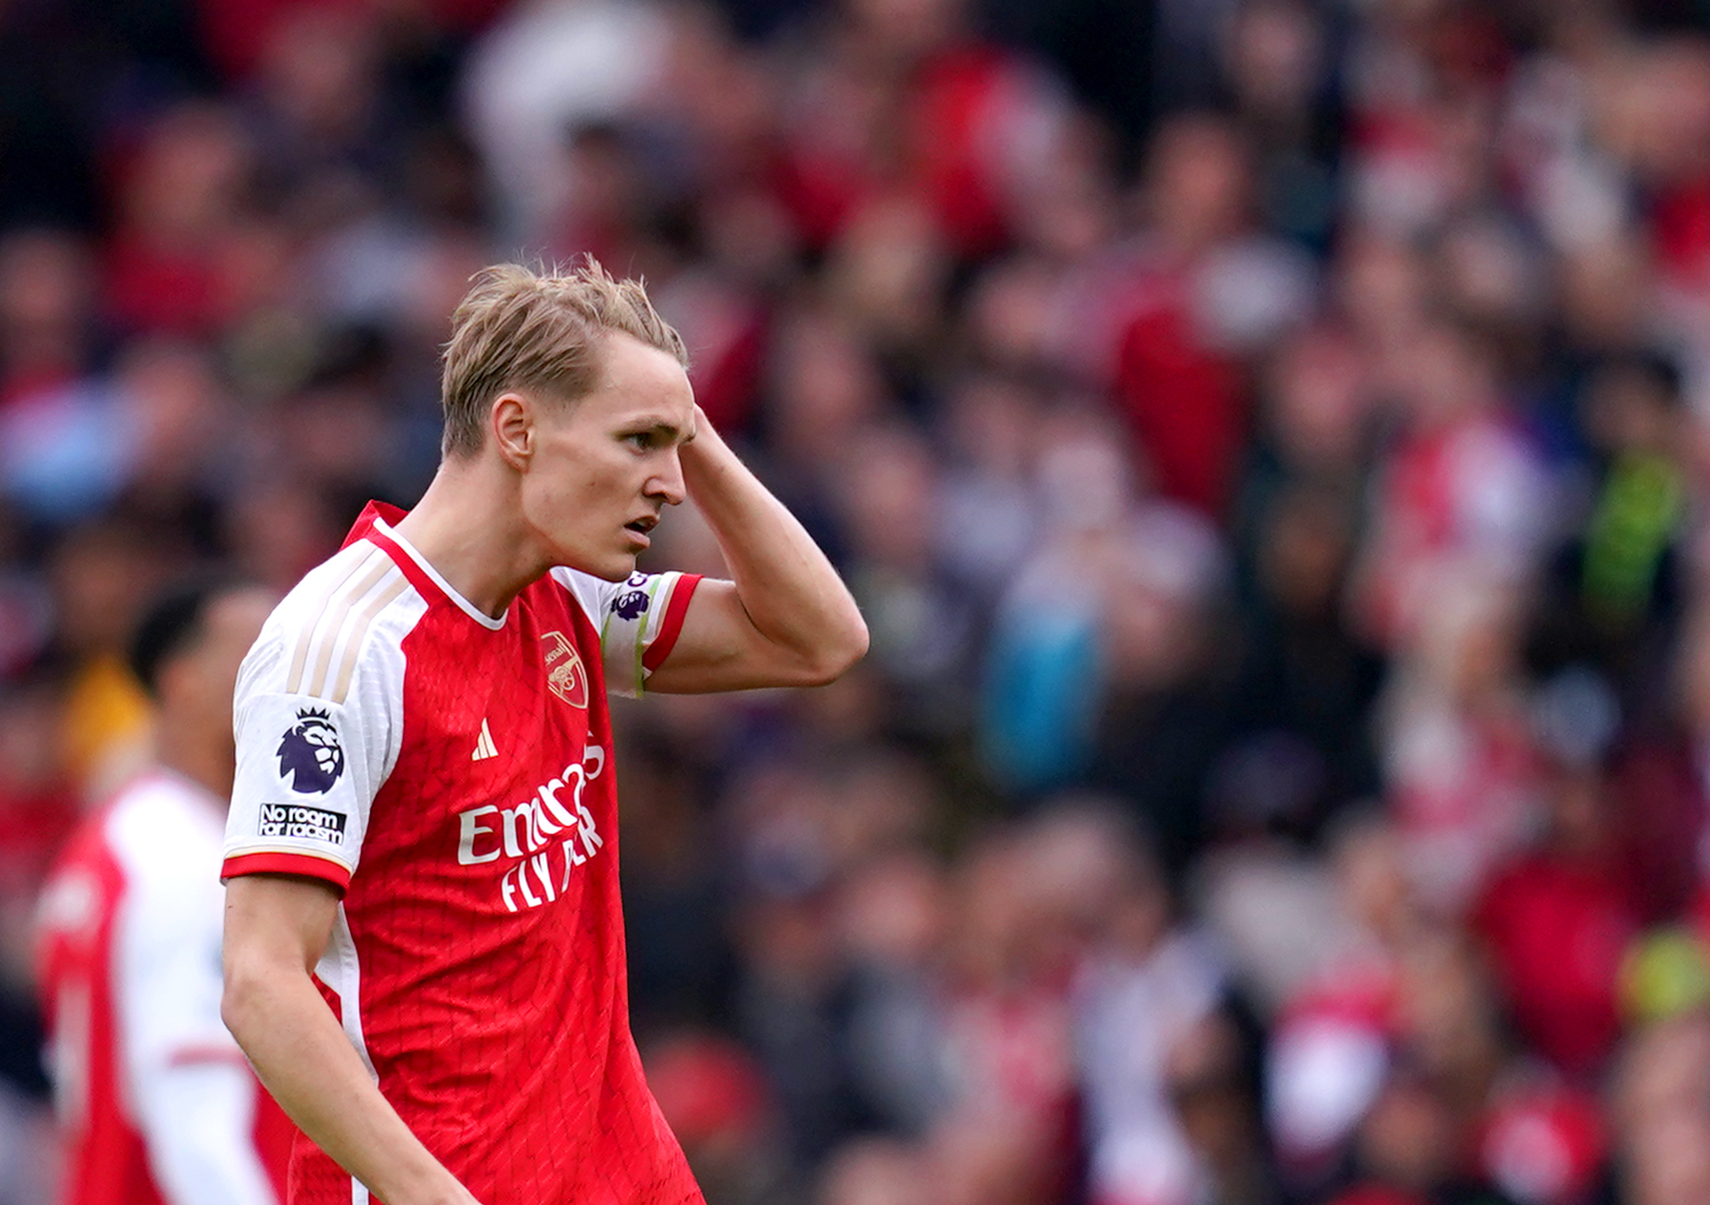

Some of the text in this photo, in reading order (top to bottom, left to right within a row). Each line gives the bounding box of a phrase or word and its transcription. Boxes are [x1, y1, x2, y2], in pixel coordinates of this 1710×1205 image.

[260, 803, 338, 829] No room
[258, 820, 344, 845] for racism
[501, 851, 556, 913] FLY
